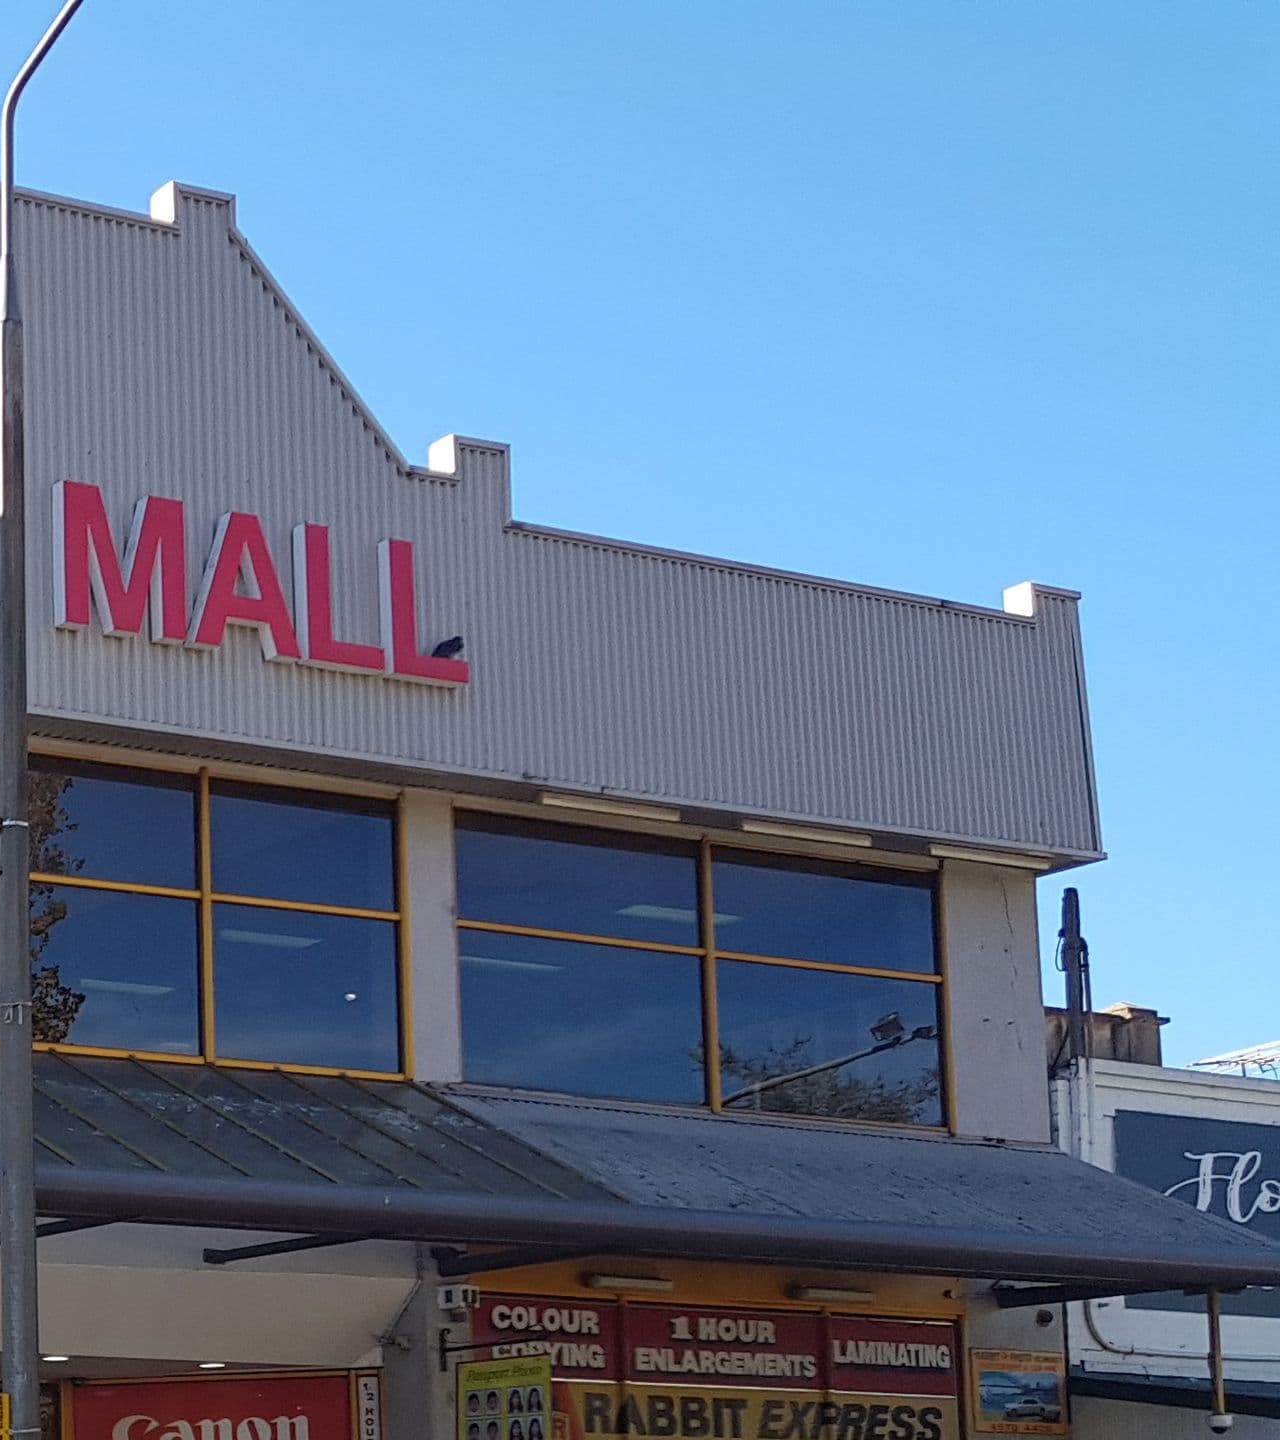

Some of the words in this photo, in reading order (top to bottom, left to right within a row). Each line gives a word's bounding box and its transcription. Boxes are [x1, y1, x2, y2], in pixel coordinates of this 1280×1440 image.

[52, 479, 470, 689] MALL
[491, 1304, 600, 1335] COLOUR
[668, 1315, 694, 1342] 1
[697, 1317, 776, 1345] HOUR
[634, 1347, 818, 1379] ENLARGEMENTS
[832, 1338, 952, 1370] LAMINATING
[583, 1391, 747, 1439] RABBIT
